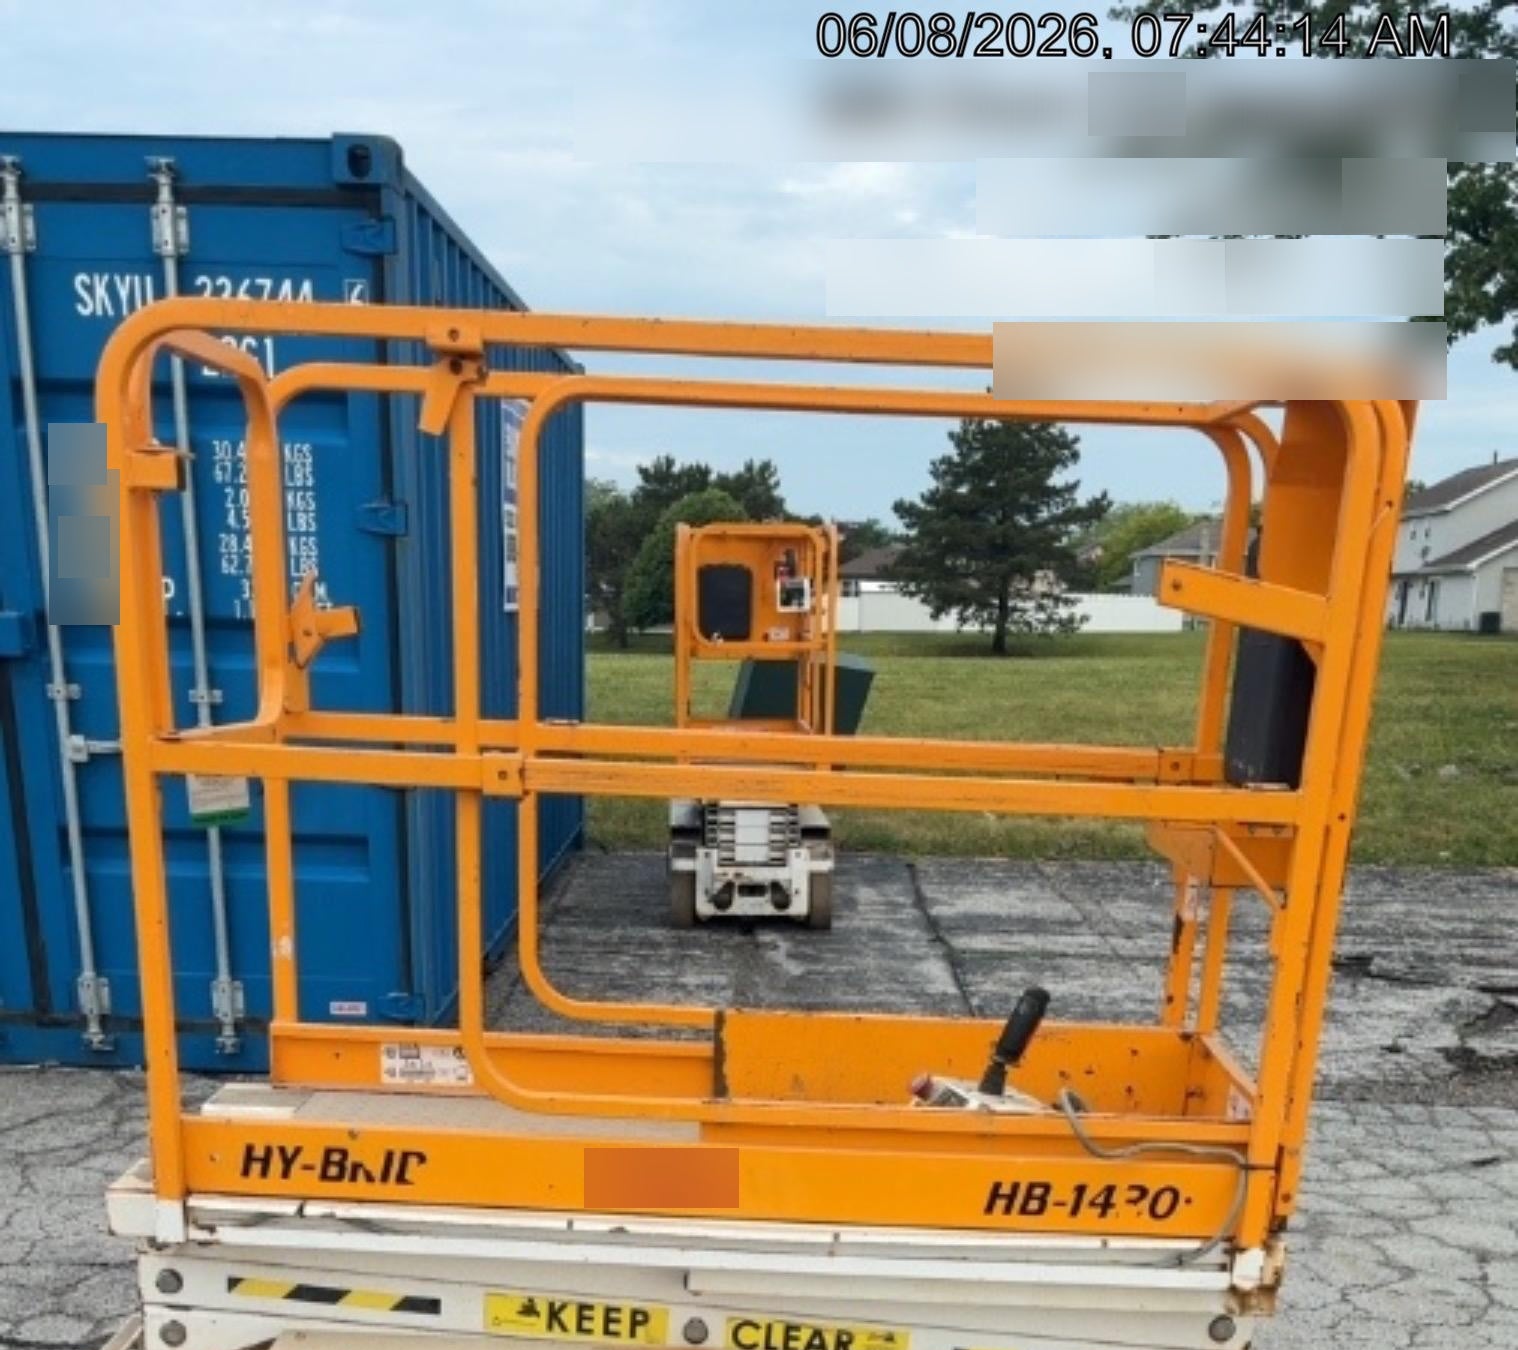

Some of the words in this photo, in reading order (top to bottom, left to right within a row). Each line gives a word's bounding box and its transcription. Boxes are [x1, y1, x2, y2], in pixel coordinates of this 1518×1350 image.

[283, 443, 313, 463] KGS
[284, 464, 315, 487] LBS
[286, 491, 316, 512] KGS
[287, 512, 317, 532] LBS
[546, 1300, 650, 1339] KEEP
